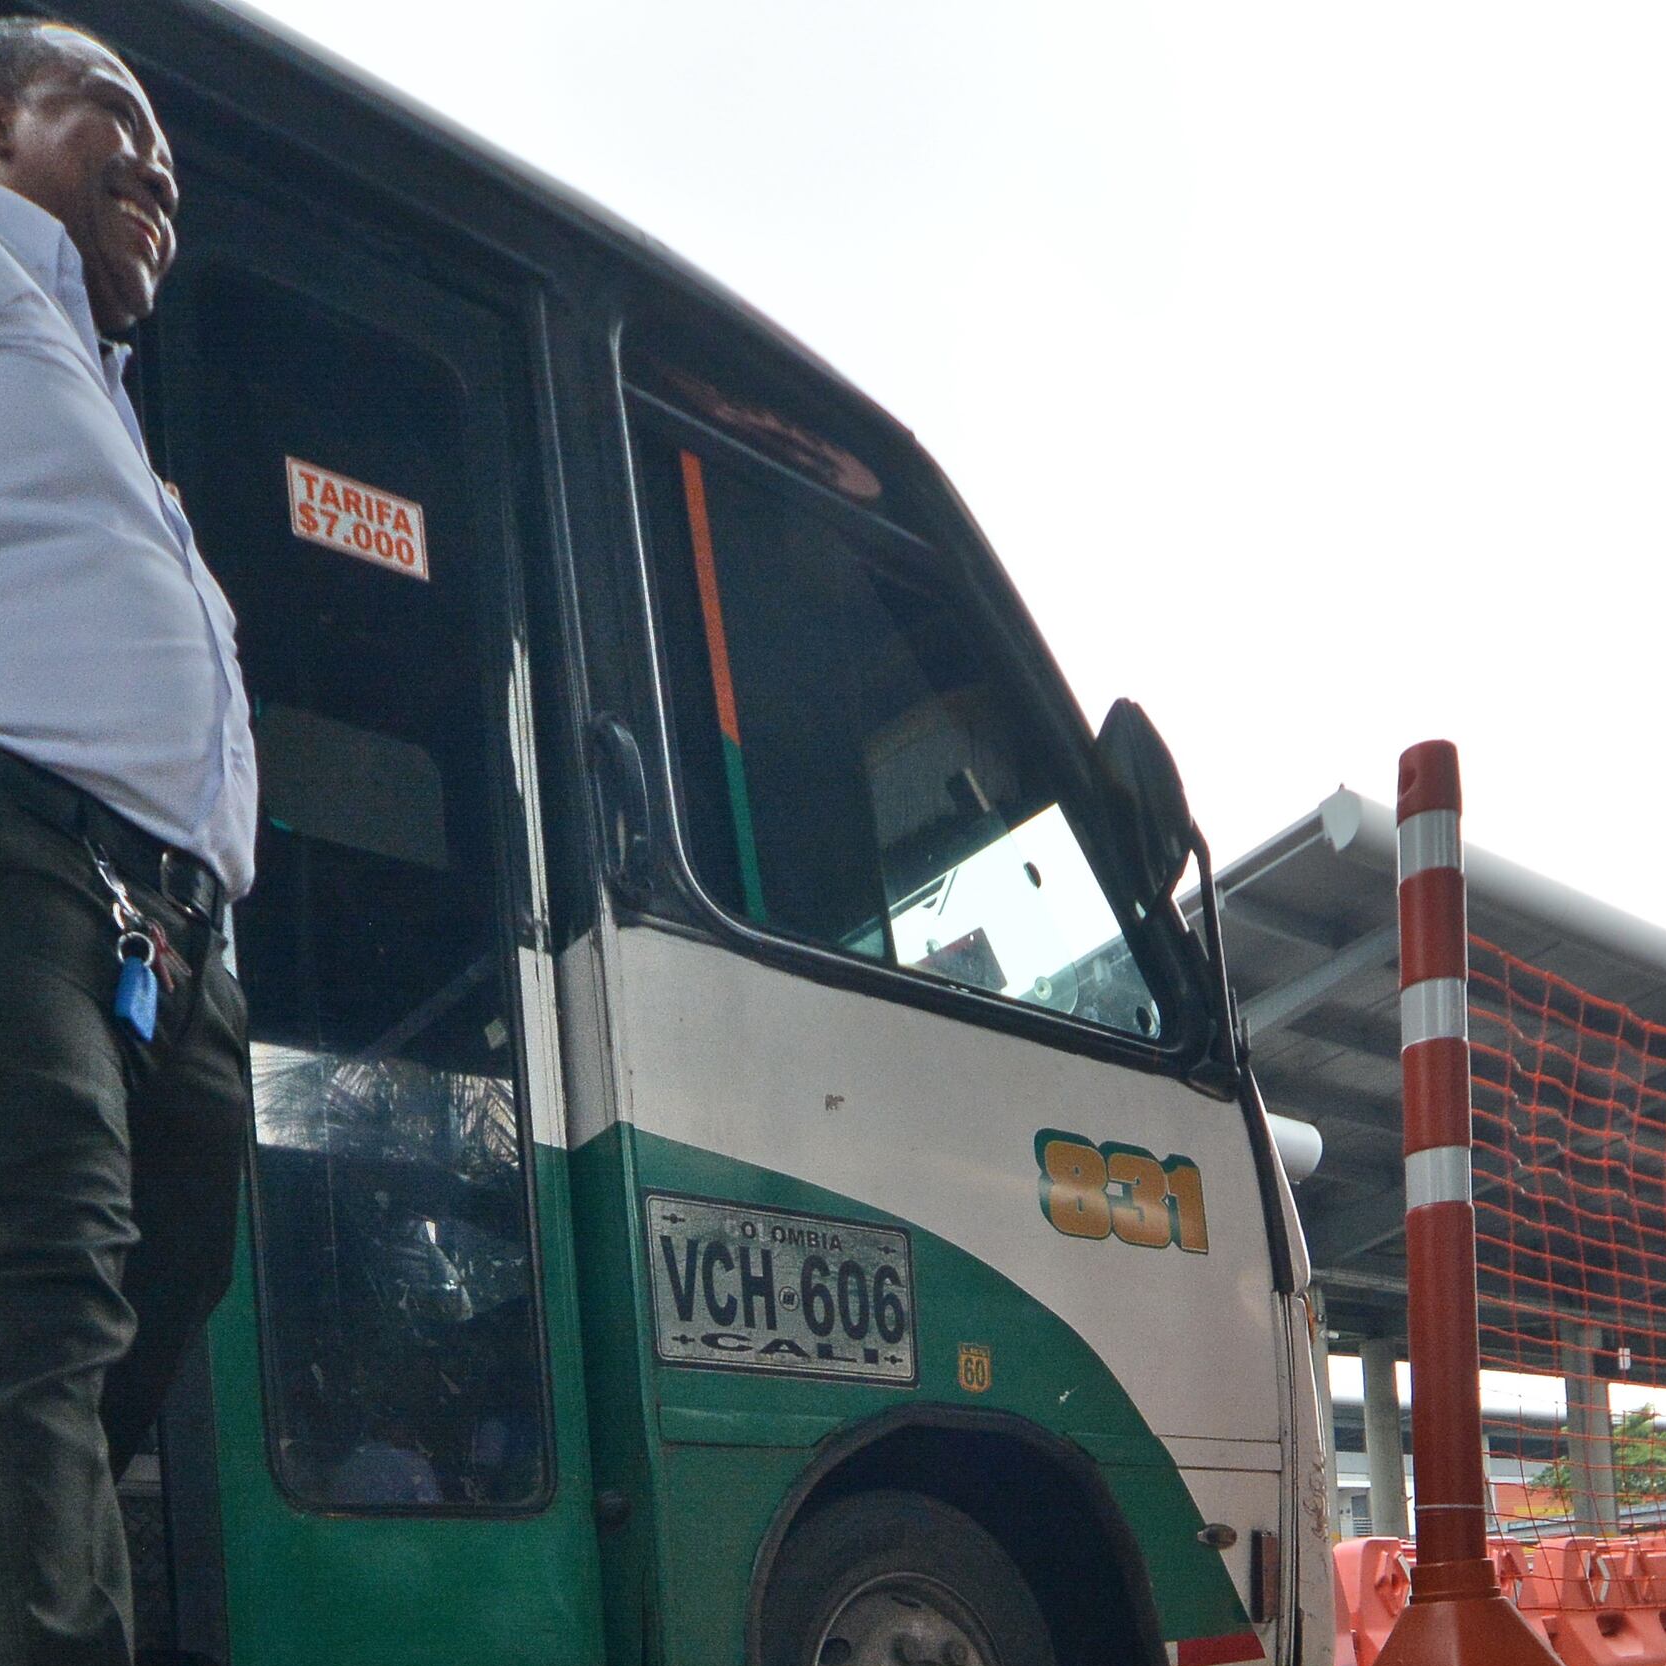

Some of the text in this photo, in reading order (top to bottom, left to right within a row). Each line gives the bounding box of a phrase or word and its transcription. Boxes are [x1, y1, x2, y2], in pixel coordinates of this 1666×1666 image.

[298, 501, 415, 566] $7.000
[299, 471, 414, 537] TARIFA
[1033, 1127, 1209, 1255] 831
[700, 1332, 880, 1366] CALI
